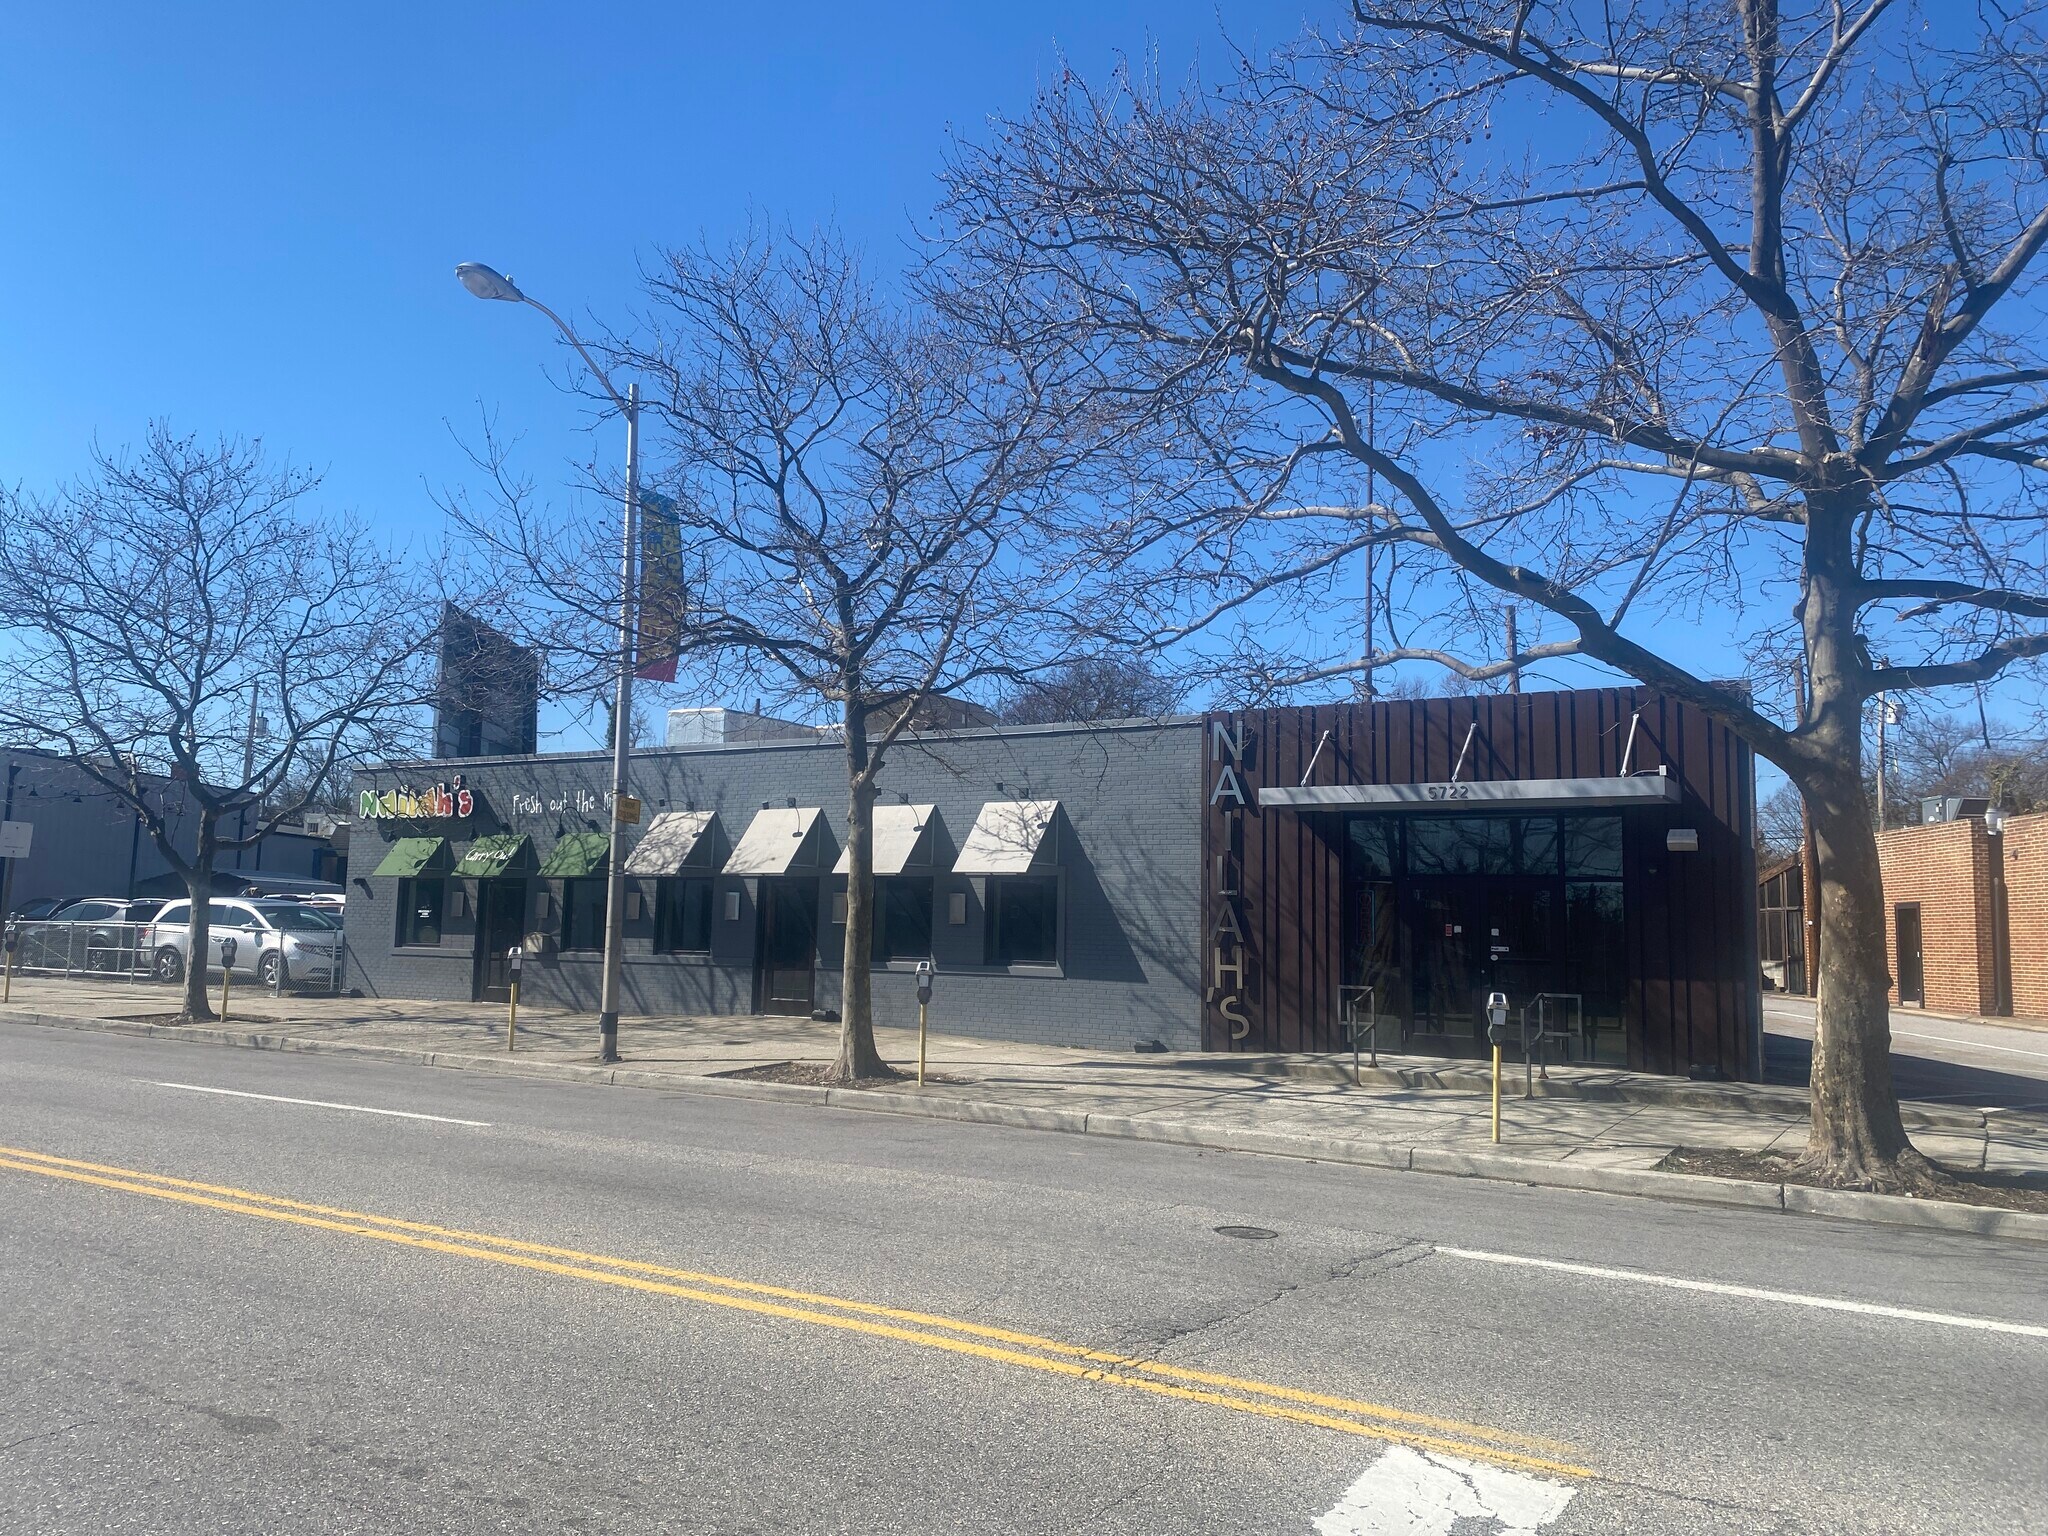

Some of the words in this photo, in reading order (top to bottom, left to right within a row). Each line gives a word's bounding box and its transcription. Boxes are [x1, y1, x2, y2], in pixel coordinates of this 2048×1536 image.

[512, 791, 542, 815] Fresh
[549, 791, 567, 813] out
[576, 789, 595, 812] the
[1428, 786, 1469, 800] 5722
[465, 848, 494, 862] Carry
[1206, 720, 1250, 1040] NAILAH'S
